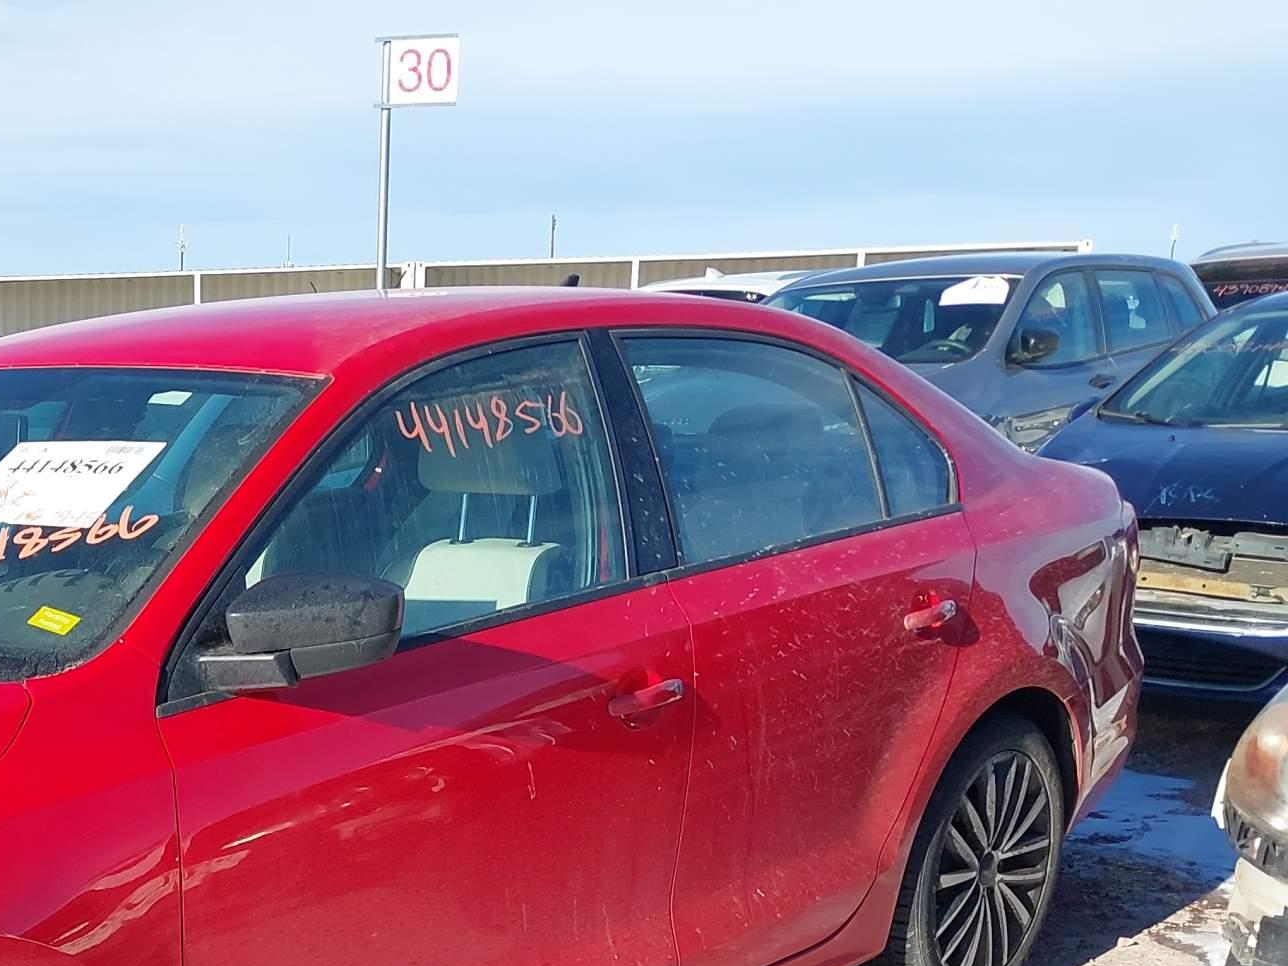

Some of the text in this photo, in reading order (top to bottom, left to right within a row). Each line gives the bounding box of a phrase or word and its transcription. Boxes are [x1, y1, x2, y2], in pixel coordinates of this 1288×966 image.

[398, 48, 452, 93] 30
[395, 391, 583, 458] 44148566
[8, 458, 129, 475] 44148566
